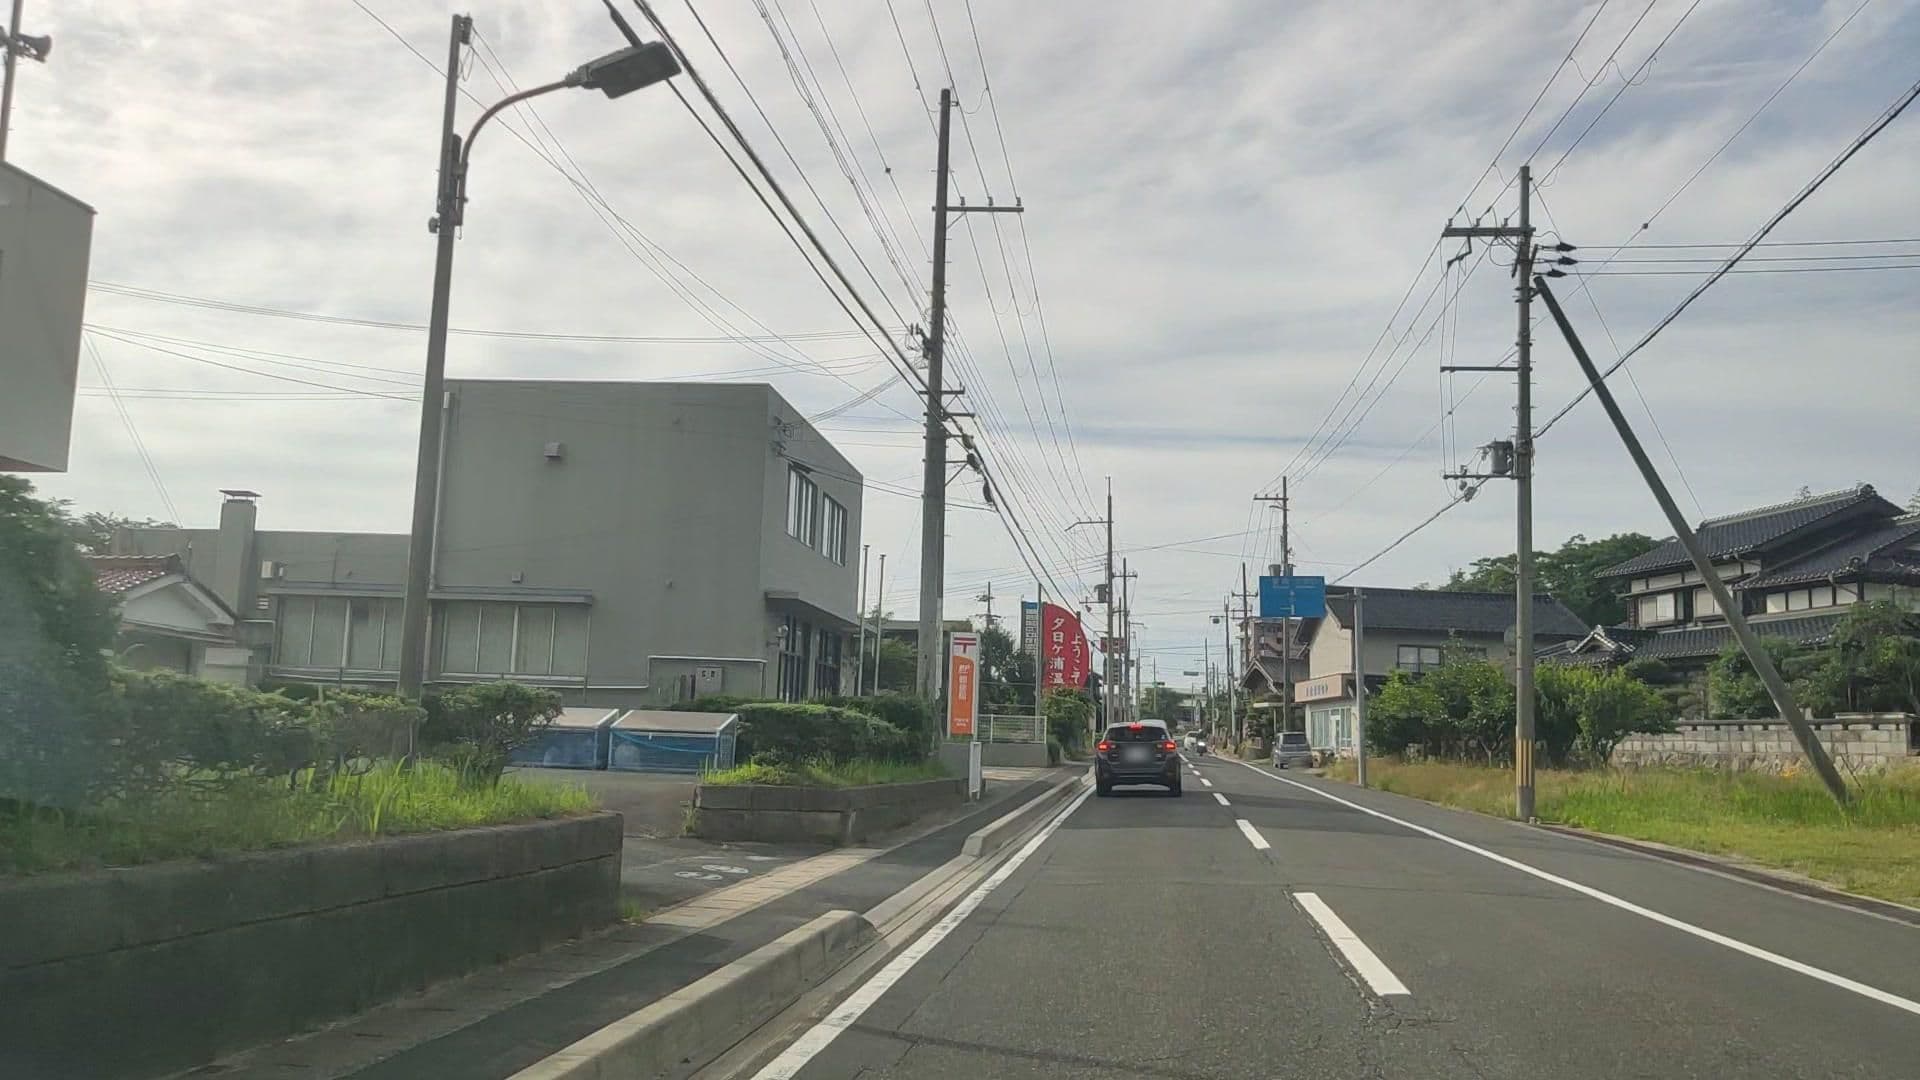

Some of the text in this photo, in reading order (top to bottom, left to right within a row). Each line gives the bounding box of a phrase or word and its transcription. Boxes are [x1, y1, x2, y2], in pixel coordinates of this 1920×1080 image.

[1048, 617, 1066, 688] 夕日ヶ浦温
[1070, 631, 1082, 685] ようこそ
